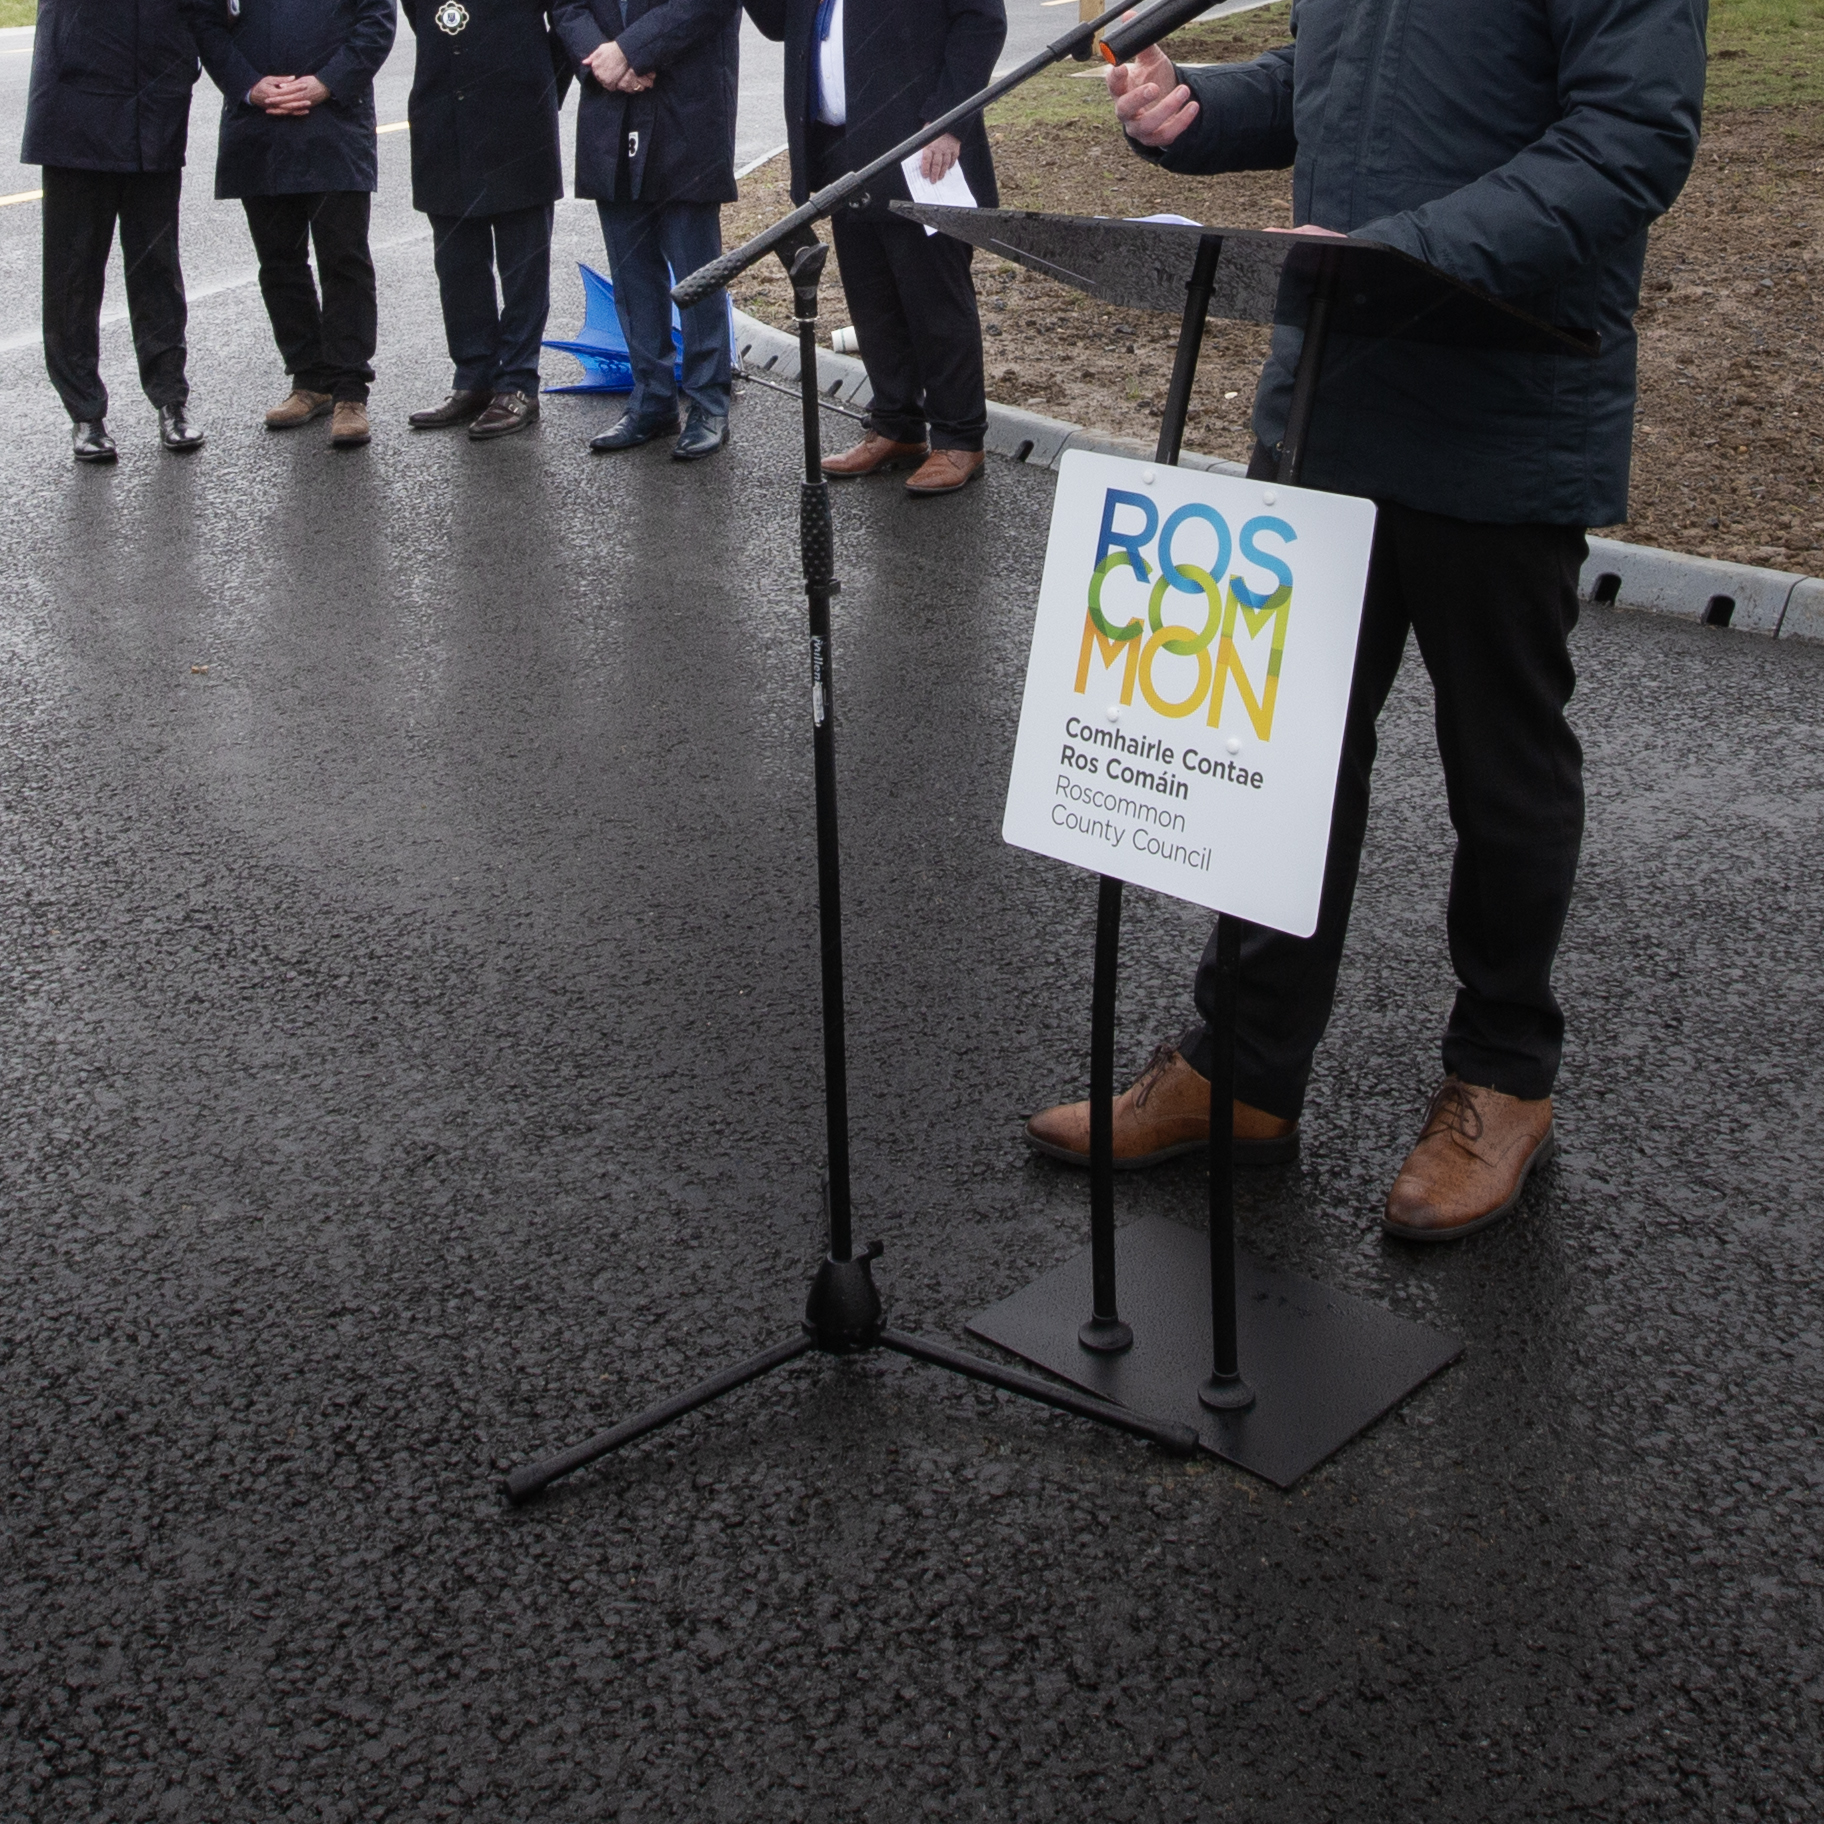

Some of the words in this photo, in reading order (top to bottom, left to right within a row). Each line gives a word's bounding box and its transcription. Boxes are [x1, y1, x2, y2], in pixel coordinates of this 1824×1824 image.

[1093, 487, 1298, 610] ROS
[1088, 550, 1293, 677] COM
[1074, 605, 1283, 742] MON
[1060, 744, 1099, 774] Ros
[1105, 760, 1189, 800] Comáin
[1065, 717, 1175, 766] Comhairle
[1181, 749, 1265, 790] Contae
[1051, 804, 1125, 847] County
[1132, 830, 1212, 872] Council
[1055, 775, 1186, 832] Roscommon
